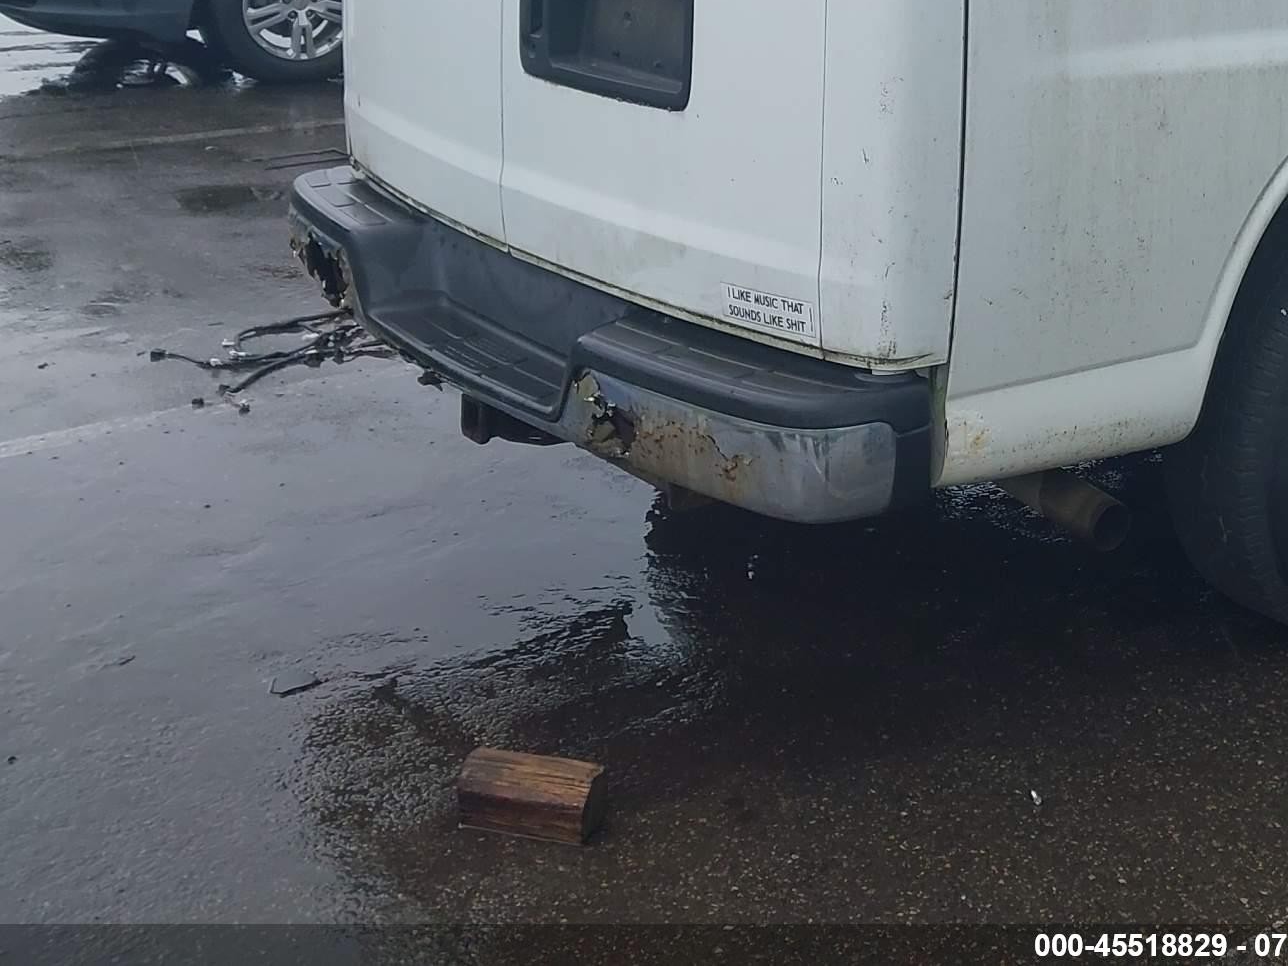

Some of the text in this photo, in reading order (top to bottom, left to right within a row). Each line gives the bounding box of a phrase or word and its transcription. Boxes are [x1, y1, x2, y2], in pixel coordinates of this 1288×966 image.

[727, 286, 804, 314] I LIKE MUSIC THAT
[728, 304, 806, 332] SOUNDS LIKE SHIT
